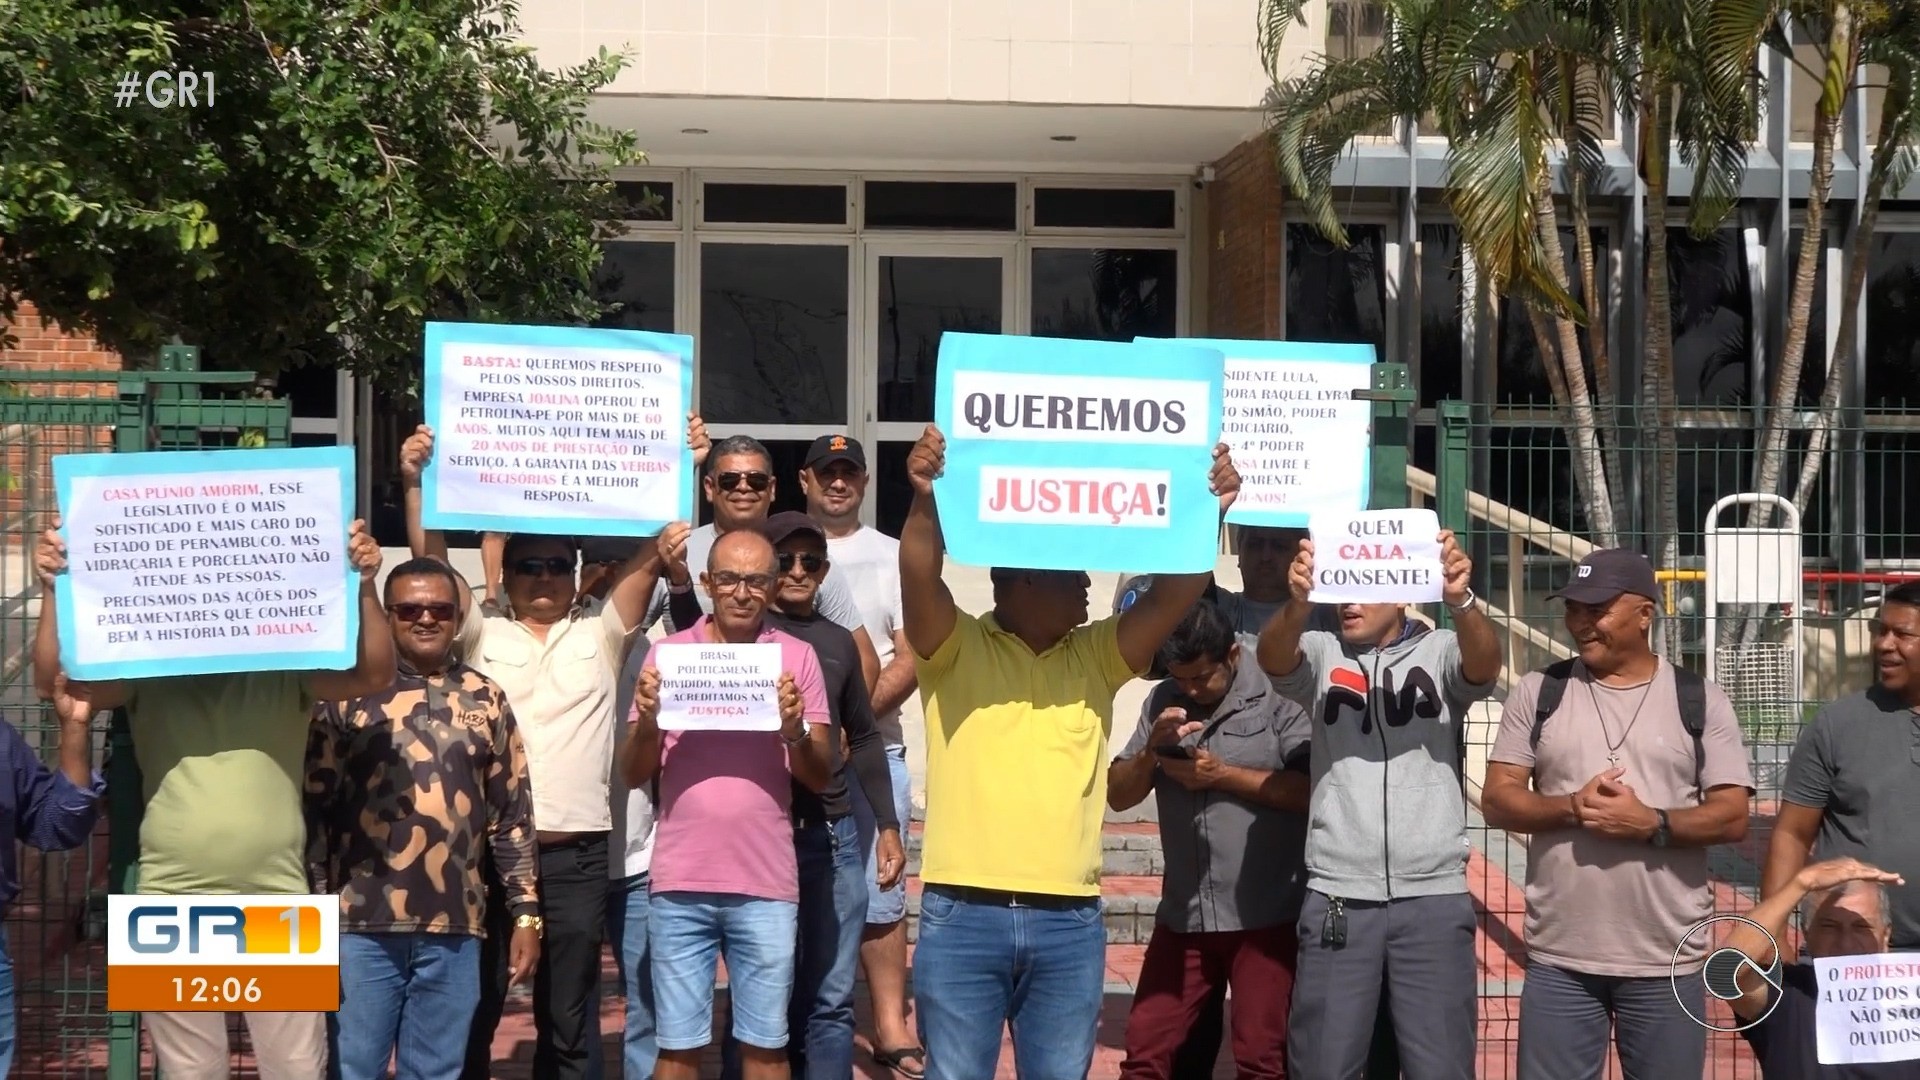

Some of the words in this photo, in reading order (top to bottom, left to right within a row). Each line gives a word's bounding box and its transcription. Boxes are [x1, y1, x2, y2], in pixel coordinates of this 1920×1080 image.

[462, 355, 521, 369] BASTA!
[525, 357, 596, 371] QUEREMOS
[600, 360, 662, 374] RESPEITO
[480, 372, 521, 385] PELOS
[525, 373, 577, 387] NOSSOS
[581, 376, 644, 389] DIREITOS.
[1282, 371, 1318, 384] LULA,
[464, 390, 524, 403] EMPRESA
[527, 392, 580, 406] JOALINA
[584, 394, 637, 407] OPEROU
[642, 396, 660, 408] EM
[1261, 389, 1313, 402] RAQUEL
[1317, 390, 1351, 401] LYRA
[461, 406, 553, 421] PETROLINA-PE
[556, 410, 583, 422] POR
[588, 411, 619, 424] MAIS
[623, 412, 640, 424] DE
[645, 413, 662, 425] 60
[963, 391, 1187, 434] QUEREMOS
[1241, 403, 1286, 418] SIMÃO,
[1291, 408, 1337, 419] PODER
[454, 423, 492, 435] ANOS.
[497, 424, 546, 437] MUITOS
[549, 427, 580, 439] AQUI
[585, 427, 610, 439] TEM
[615, 428, 646, 440] MAIS
[650, 429, 668, 441] DE
[471, 439, 489, 451] 20
[493, 440, 528, 452] ANOS
[532, 441, 549, 453] DE
[553, 441, 628, 457] PRESTAÇÃO
[632, 445, 650, 456] DE
[1259, 440, 1305, 452] PODER
[448, 454, 508, 470] SERVIÇO.
[512, 457, 521, 468] A
[525, 457, 587, 471] GARANTIA
[592, 459, 617, 472] DAS
[620, 460, 671, 474] VERBAS
[1262, 458, 1299, 470] LIVRE
[1304, 459, 1311, 470] E
[479, 470, 557, 485] RECISÓRIAS
[561, 472, 569, 486] É
[572, 475, 581, 486] A
[585, 475, 639, 488] MELHOR
[103, 488, 141, 502] CASA
[201, 483, 264, 497] AMORIM,
[269, 481, 304, 495] ESSE
[523, 489, 594, 503] RESPOSTA.
[124, 502, 216, 518] LEGISLATIVO
[222, 499, 230, 514] É
[235, 502, 245, 513] O
[251, 500, 286, 513] MAIS
[988, 477, 1168, 525] JUSTIÇA!
[95, 521, 191, 537] SOFISTICADO
[197, 520, 206, 532] E
[211, 519, 246, 532] MAIS
[251, 517, 290, 530] CARO
[295, 516, 316, 529] DO
[1347, 519, 1404, 537] QUEM
[94, 540, 150, 554] ESTADO
[156, 539, 175, 551] DE
[181, 535, 286, 550] PERNAMBUCO.
[290, 533, 320, 546] MAS
[1338, 543, 1412, 562] CALA,
[85, 556, 173, 573] VIDRAÇARIA
[178, 556, 187, 568] E
[192, 552, 296, 567] PORCELANATO
[301, 548, 330, 563] NÃO
[132, 573, 188, 588] ATENDE
[193, 571, 211, 585] AS
[217, 569, 286, 583] PESSOAS.
[1319, 568, 1430, 586] CONSENTE!
[103, 592, 197, 608] PRECISAMOS
[202, 591, 230, 604] DAS
[236, 587, 283, 605] AÇÕES
[288, 587, 317, 601] DOS
[97, 609, 220, 626] PARLAMENTARES
[224, 607, 254, 622] QUE
[258, 604, 326, 619] CONHECE
[108, 630, 139, 644] BEM
[143, 630, 153, 642] A
[157, 624, 226, 641] HISTÓRIA
[231, 625, 250, 637] DA
[256, 621, 318, 637] JOALINA.
[700, 651, 737, 660] BRASIL
[677, 665, 761, 674] POLITICAMENTE
[663, 680, 715, 689] DIVIDIDO,
[719, 680, 740, 689] MAS
[744, 680, 775, 689] AINDA
[673, 692, 748, 701] ACREDITAMOS
[751, 692, 766, 701] NA
[688, 706, 750, 718] JUSTIÇA!
[1829, 967, 1839, 982] O
[1825, 989, 1833, 1003] A
[1839, 986, 1867, 1003] VOZ
[1873, 985, 1909, 1001] DOS
[1850, 1006, 1881, 1023] NÃO
[1887, 1004, 1920, 1021] SÃO
